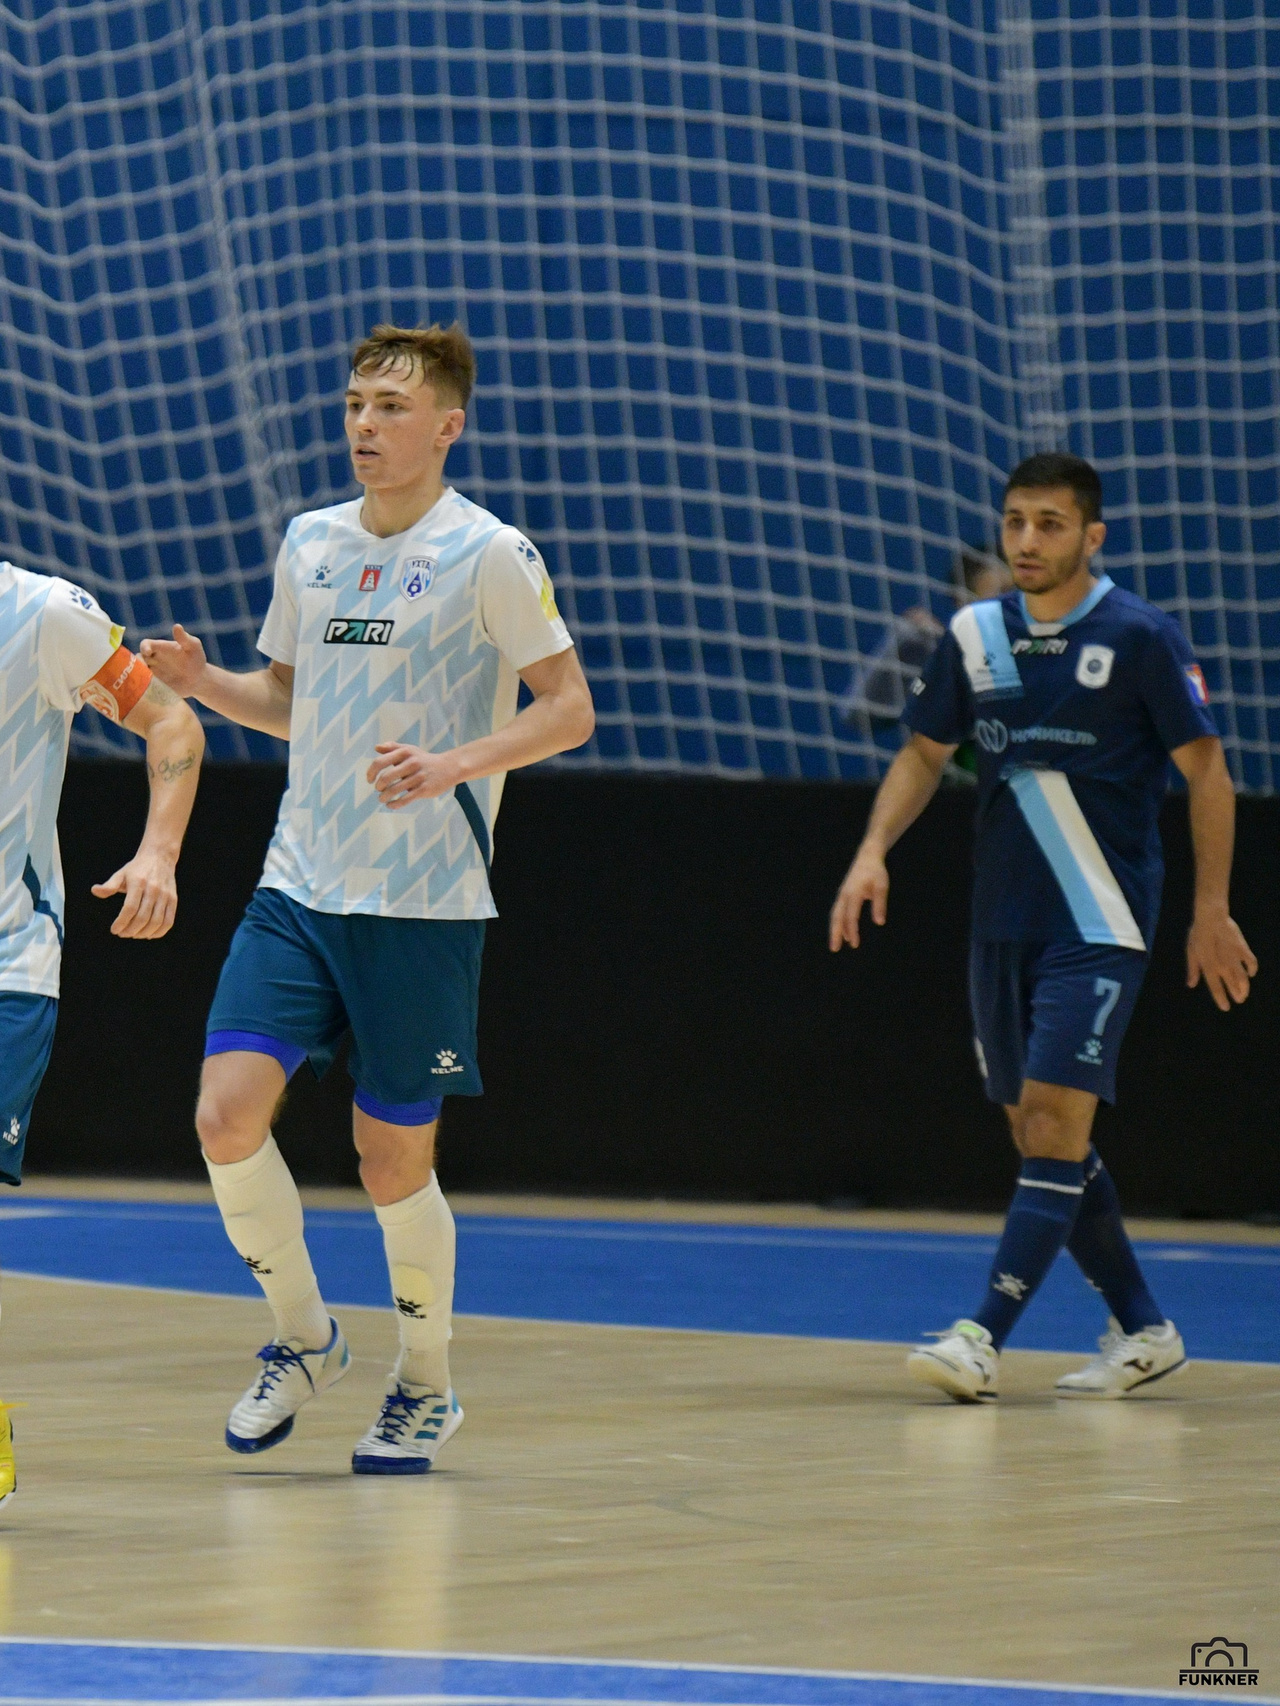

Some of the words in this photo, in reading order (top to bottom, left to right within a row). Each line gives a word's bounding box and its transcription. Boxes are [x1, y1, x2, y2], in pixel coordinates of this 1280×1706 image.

[325, 620, 393, 643] PARI
[1094, 977, 1122, 1036] 7
[430, 1065, 464, 1075] KELME
